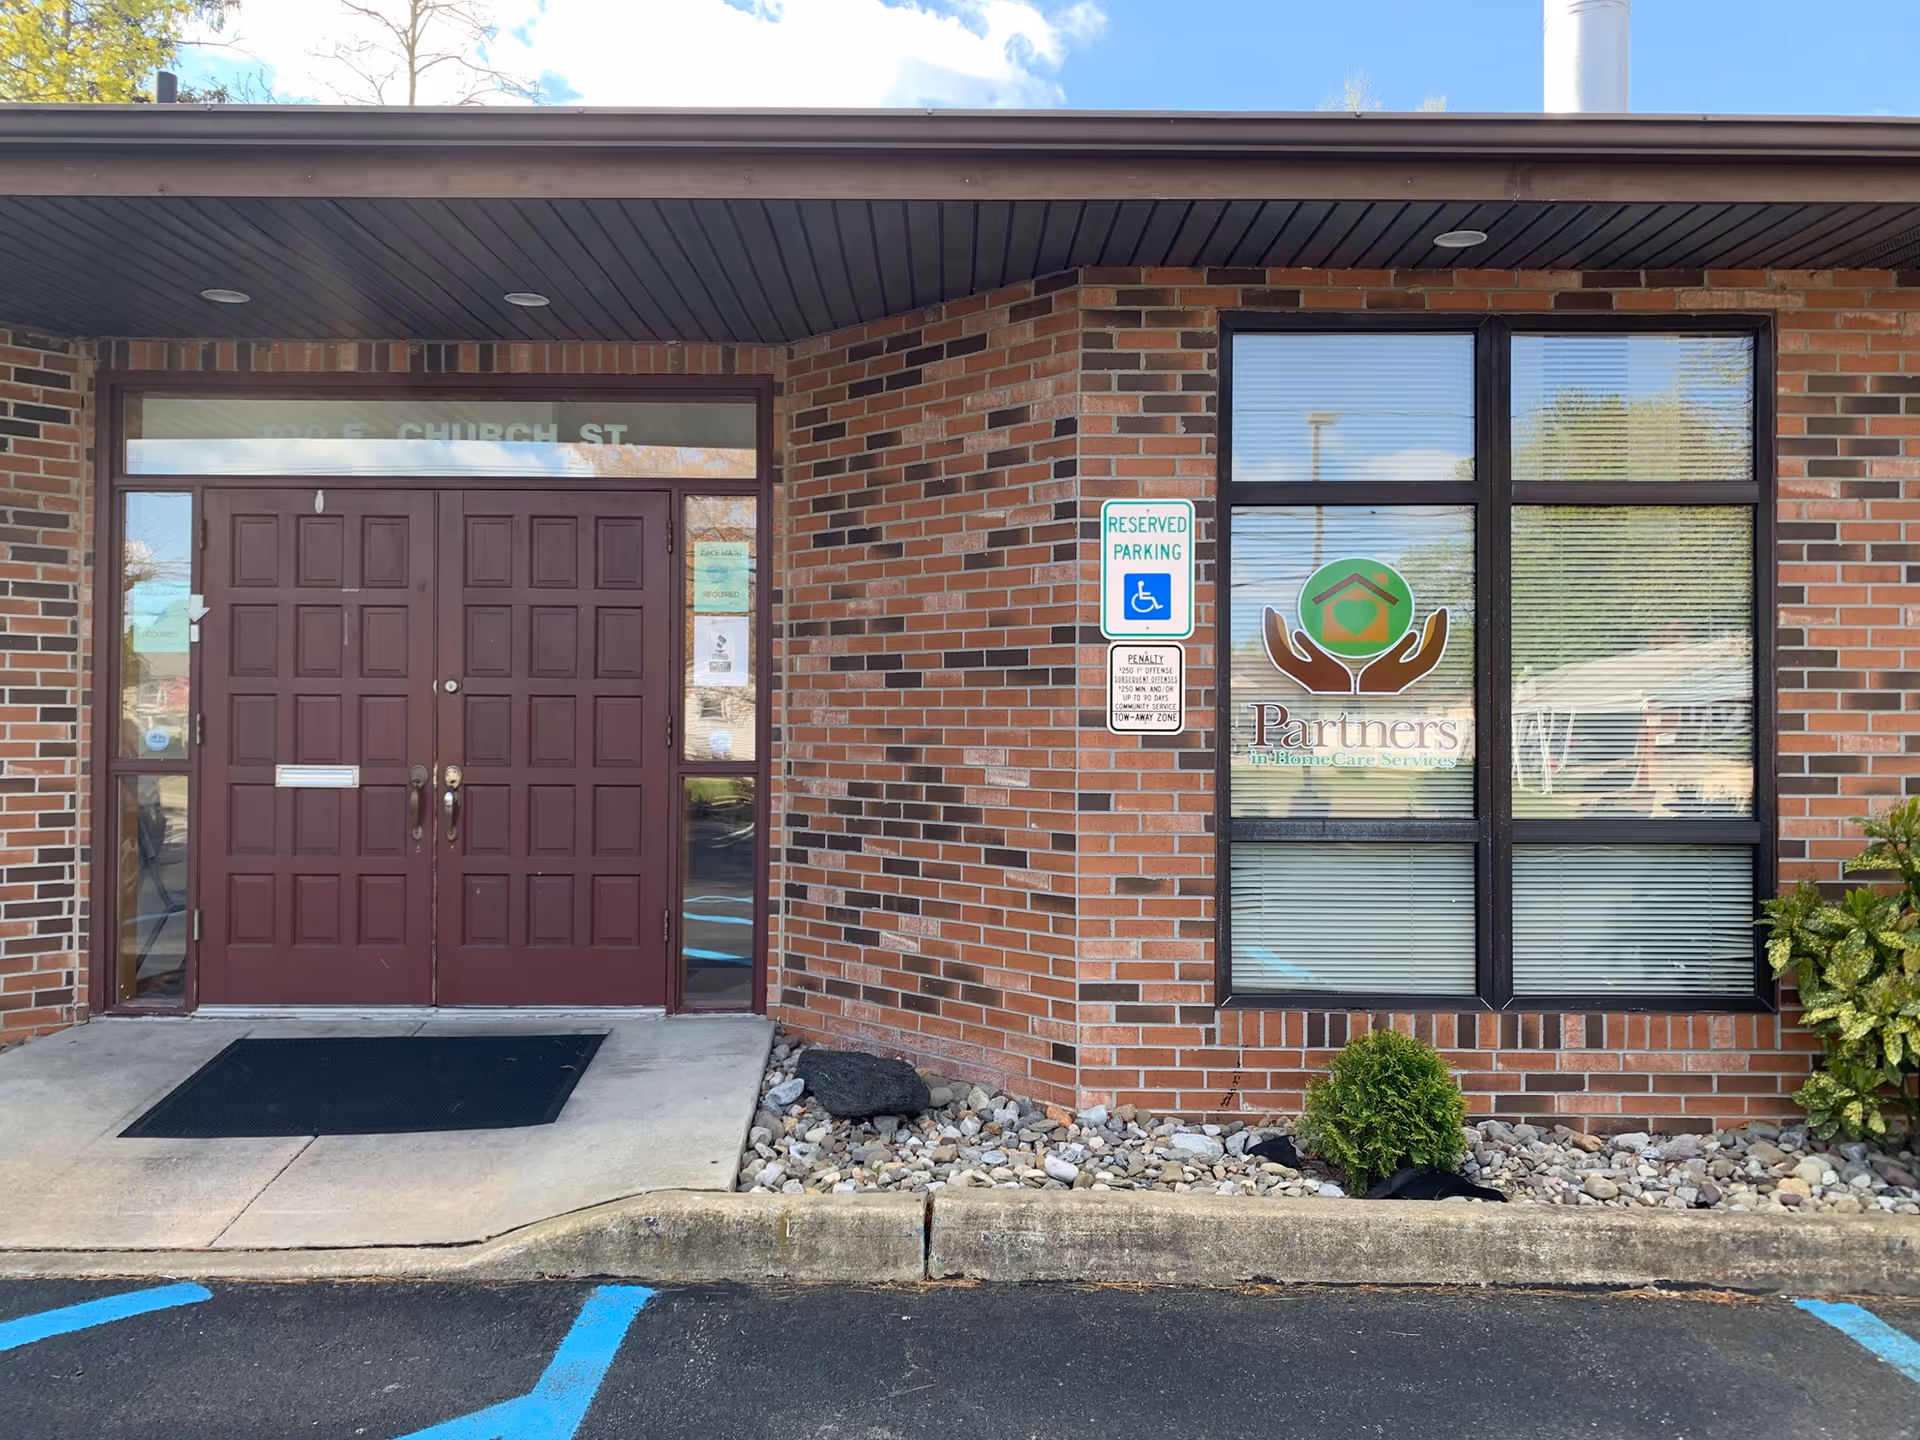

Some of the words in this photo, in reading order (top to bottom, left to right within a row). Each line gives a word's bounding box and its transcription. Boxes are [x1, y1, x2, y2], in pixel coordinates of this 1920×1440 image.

[398, 422, 558, 442] CHURCH
[1108, 516, 1187, 533] RESERVED
[1113, 543, 1182, 560] PARKING
[1128, 654, 1164, 665] PENALTY
[1114, 676, 1149, 684] SUBSEQUENT
[1150, 676, 1178, 684] OFFENSES
[1114, 713, 1154, 721] TOW-AWAY
[1157, 713, 1177, 722] ZONE
[1249, 703, 1459, 750] Partners
[1251, 750, 1268, 766] in
[1274, 750, 1376, 767] HomeCare
[1381, 752, 1456, 768] Services
